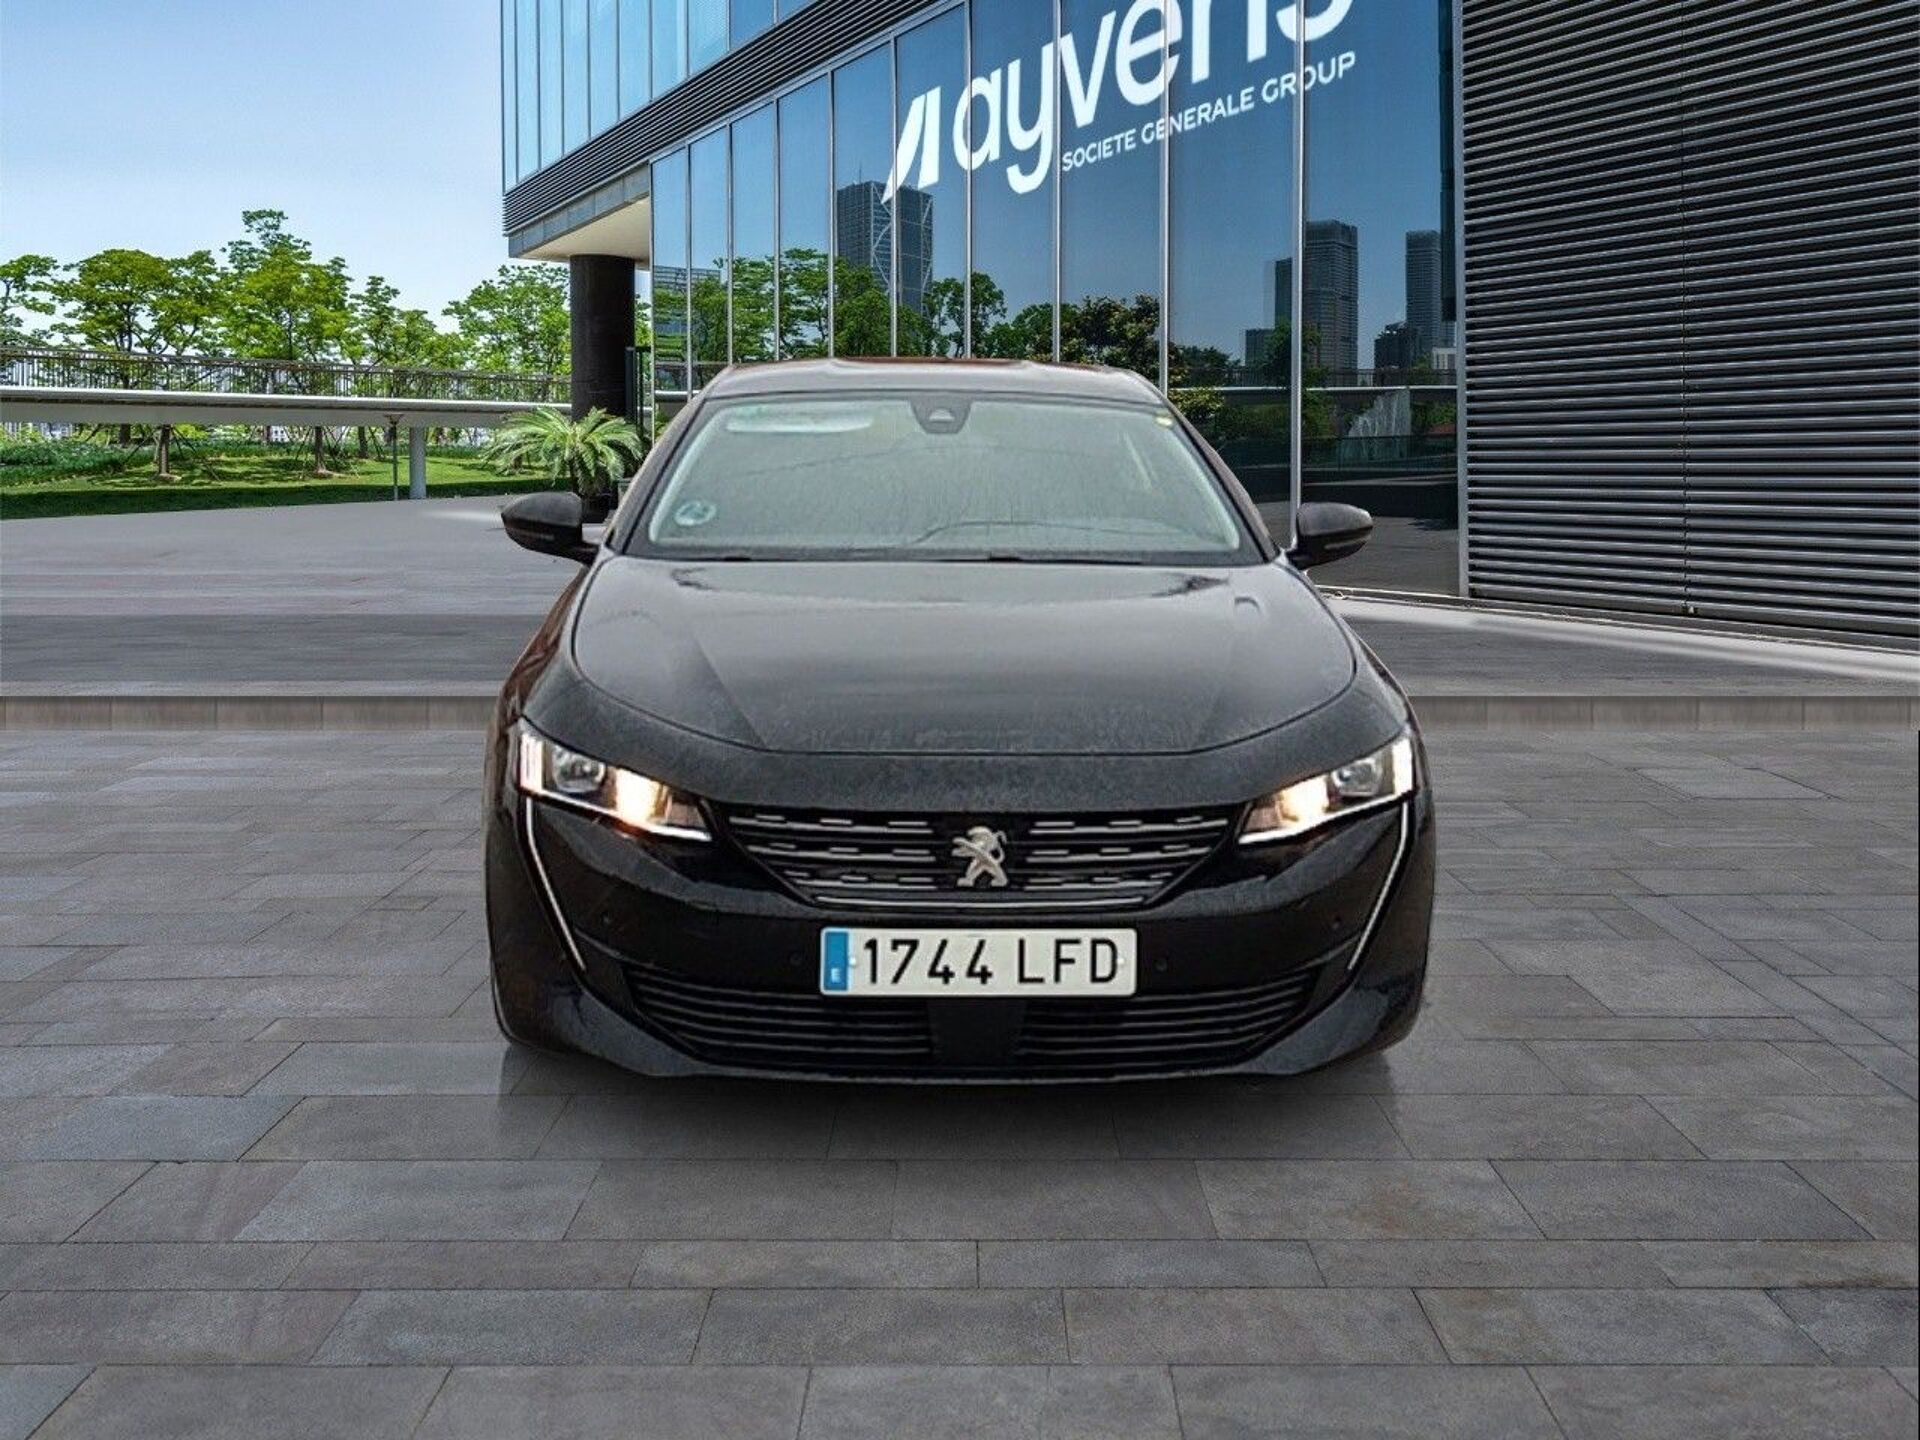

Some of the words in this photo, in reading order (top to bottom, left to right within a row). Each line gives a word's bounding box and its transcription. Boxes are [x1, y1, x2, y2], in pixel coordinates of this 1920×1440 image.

[1061, 128, 1137, 172] SOCIETE
[1141, 86, 1255, 145] GENERALE
[1261, 50, 1356, 103] GROUP
[830, 968, 841, 983] E
[863, 938, 993, 985] 1744
[1017, 938, 1118, 984] LFD
